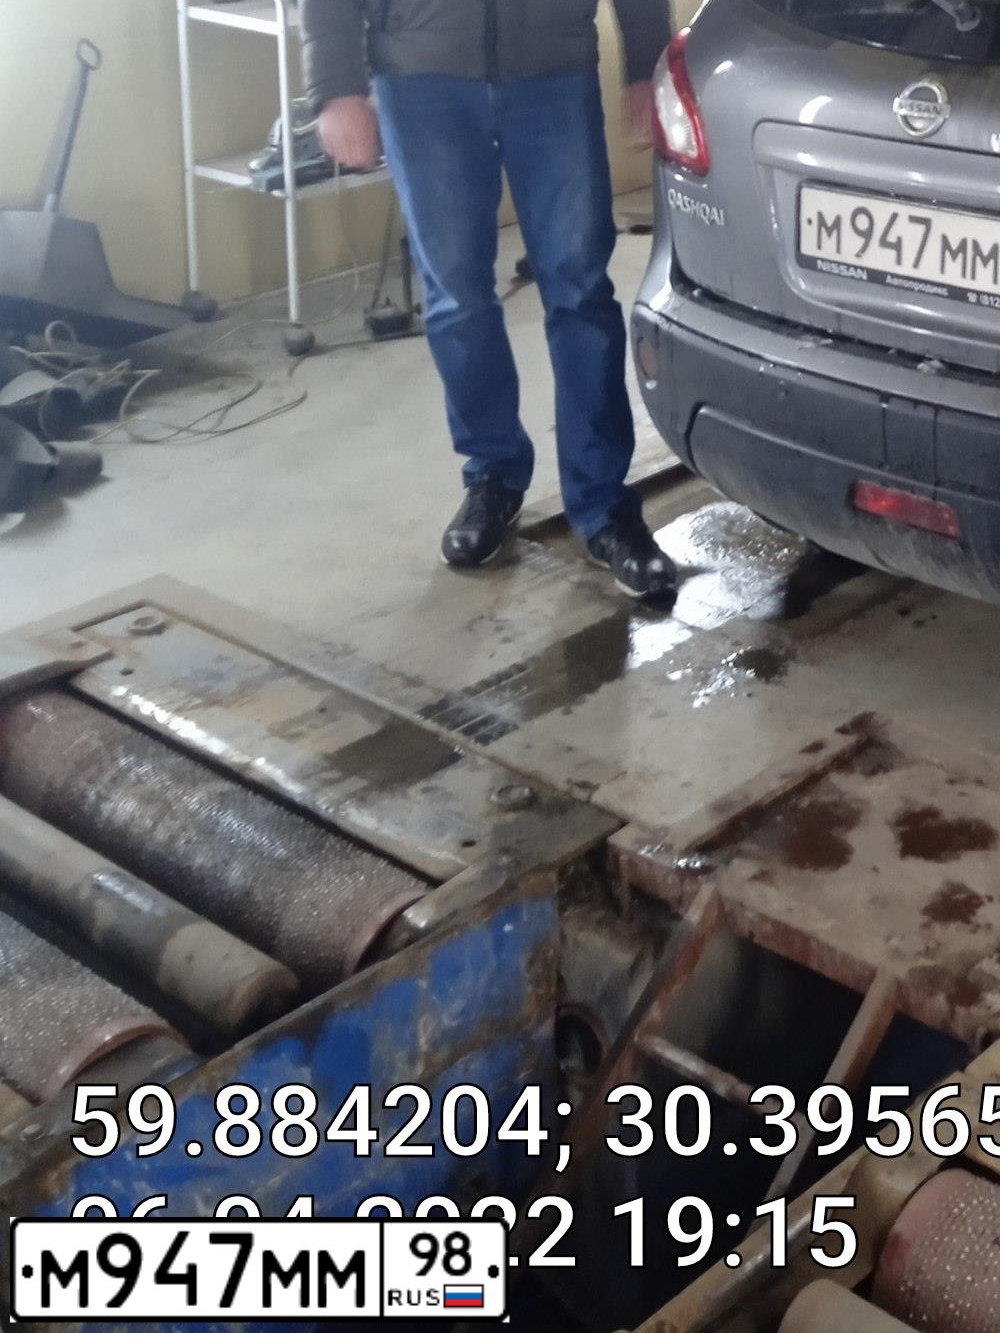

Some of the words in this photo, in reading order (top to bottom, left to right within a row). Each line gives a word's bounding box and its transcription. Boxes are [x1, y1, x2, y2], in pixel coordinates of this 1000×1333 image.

[667, 187, 726, 227] QASHQAI
[815, 205, 999, 285] М947ММ
[816, 259, 868, 281] NISSAN
